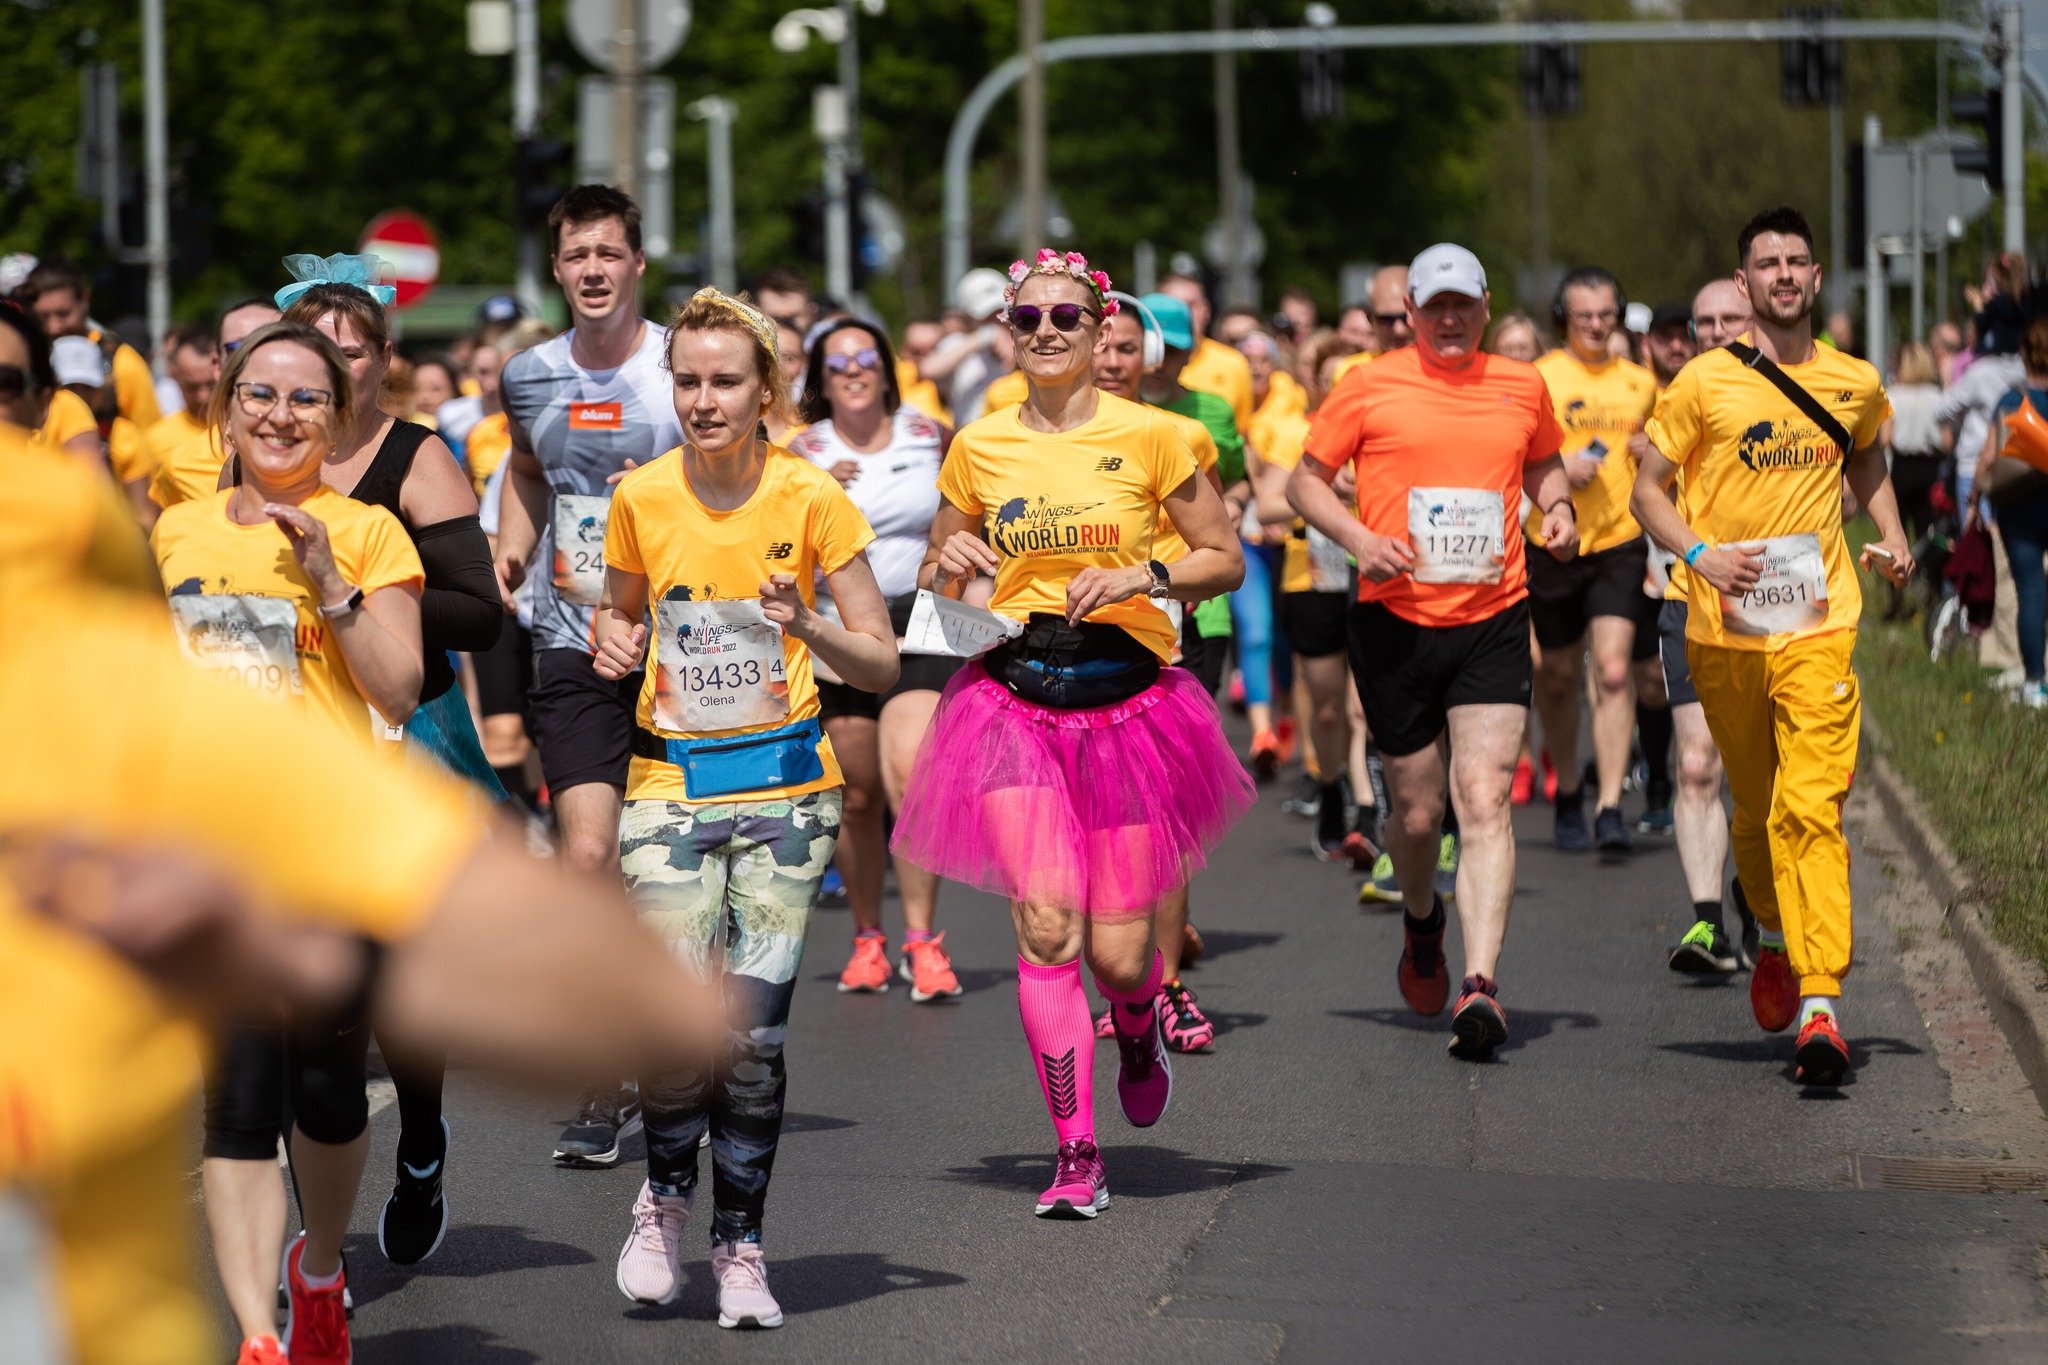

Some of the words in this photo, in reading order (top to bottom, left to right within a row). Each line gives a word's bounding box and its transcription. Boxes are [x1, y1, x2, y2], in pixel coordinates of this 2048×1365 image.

[580, 409, 614, 421] blum
[1757, 446, 1814, 468] WORLD
[1026, 505, 1074, 519] WINGS
[1032, 517, 1060, 529] LIFE
[1008, 525, 1078, 553] WORLD
[1080, 524, 1120, 546] RUN
[1427, 534, 1489, 555] 11277
[1496, 536, 1504, 553] 3
[294, 623, 324, 651] UN
[693, 624, 733, 637] WINGS
[700, 635, 722, 646] LIFE
[688, 645, 707, 655] WORLD
[707, 645, 721, 654] RUN
[722, 643, 737, 653] 2022
[771, 659, 784, 675] 4
[679, 659, 761, 692] 13433
[699, 695, 736, 707] Olena
